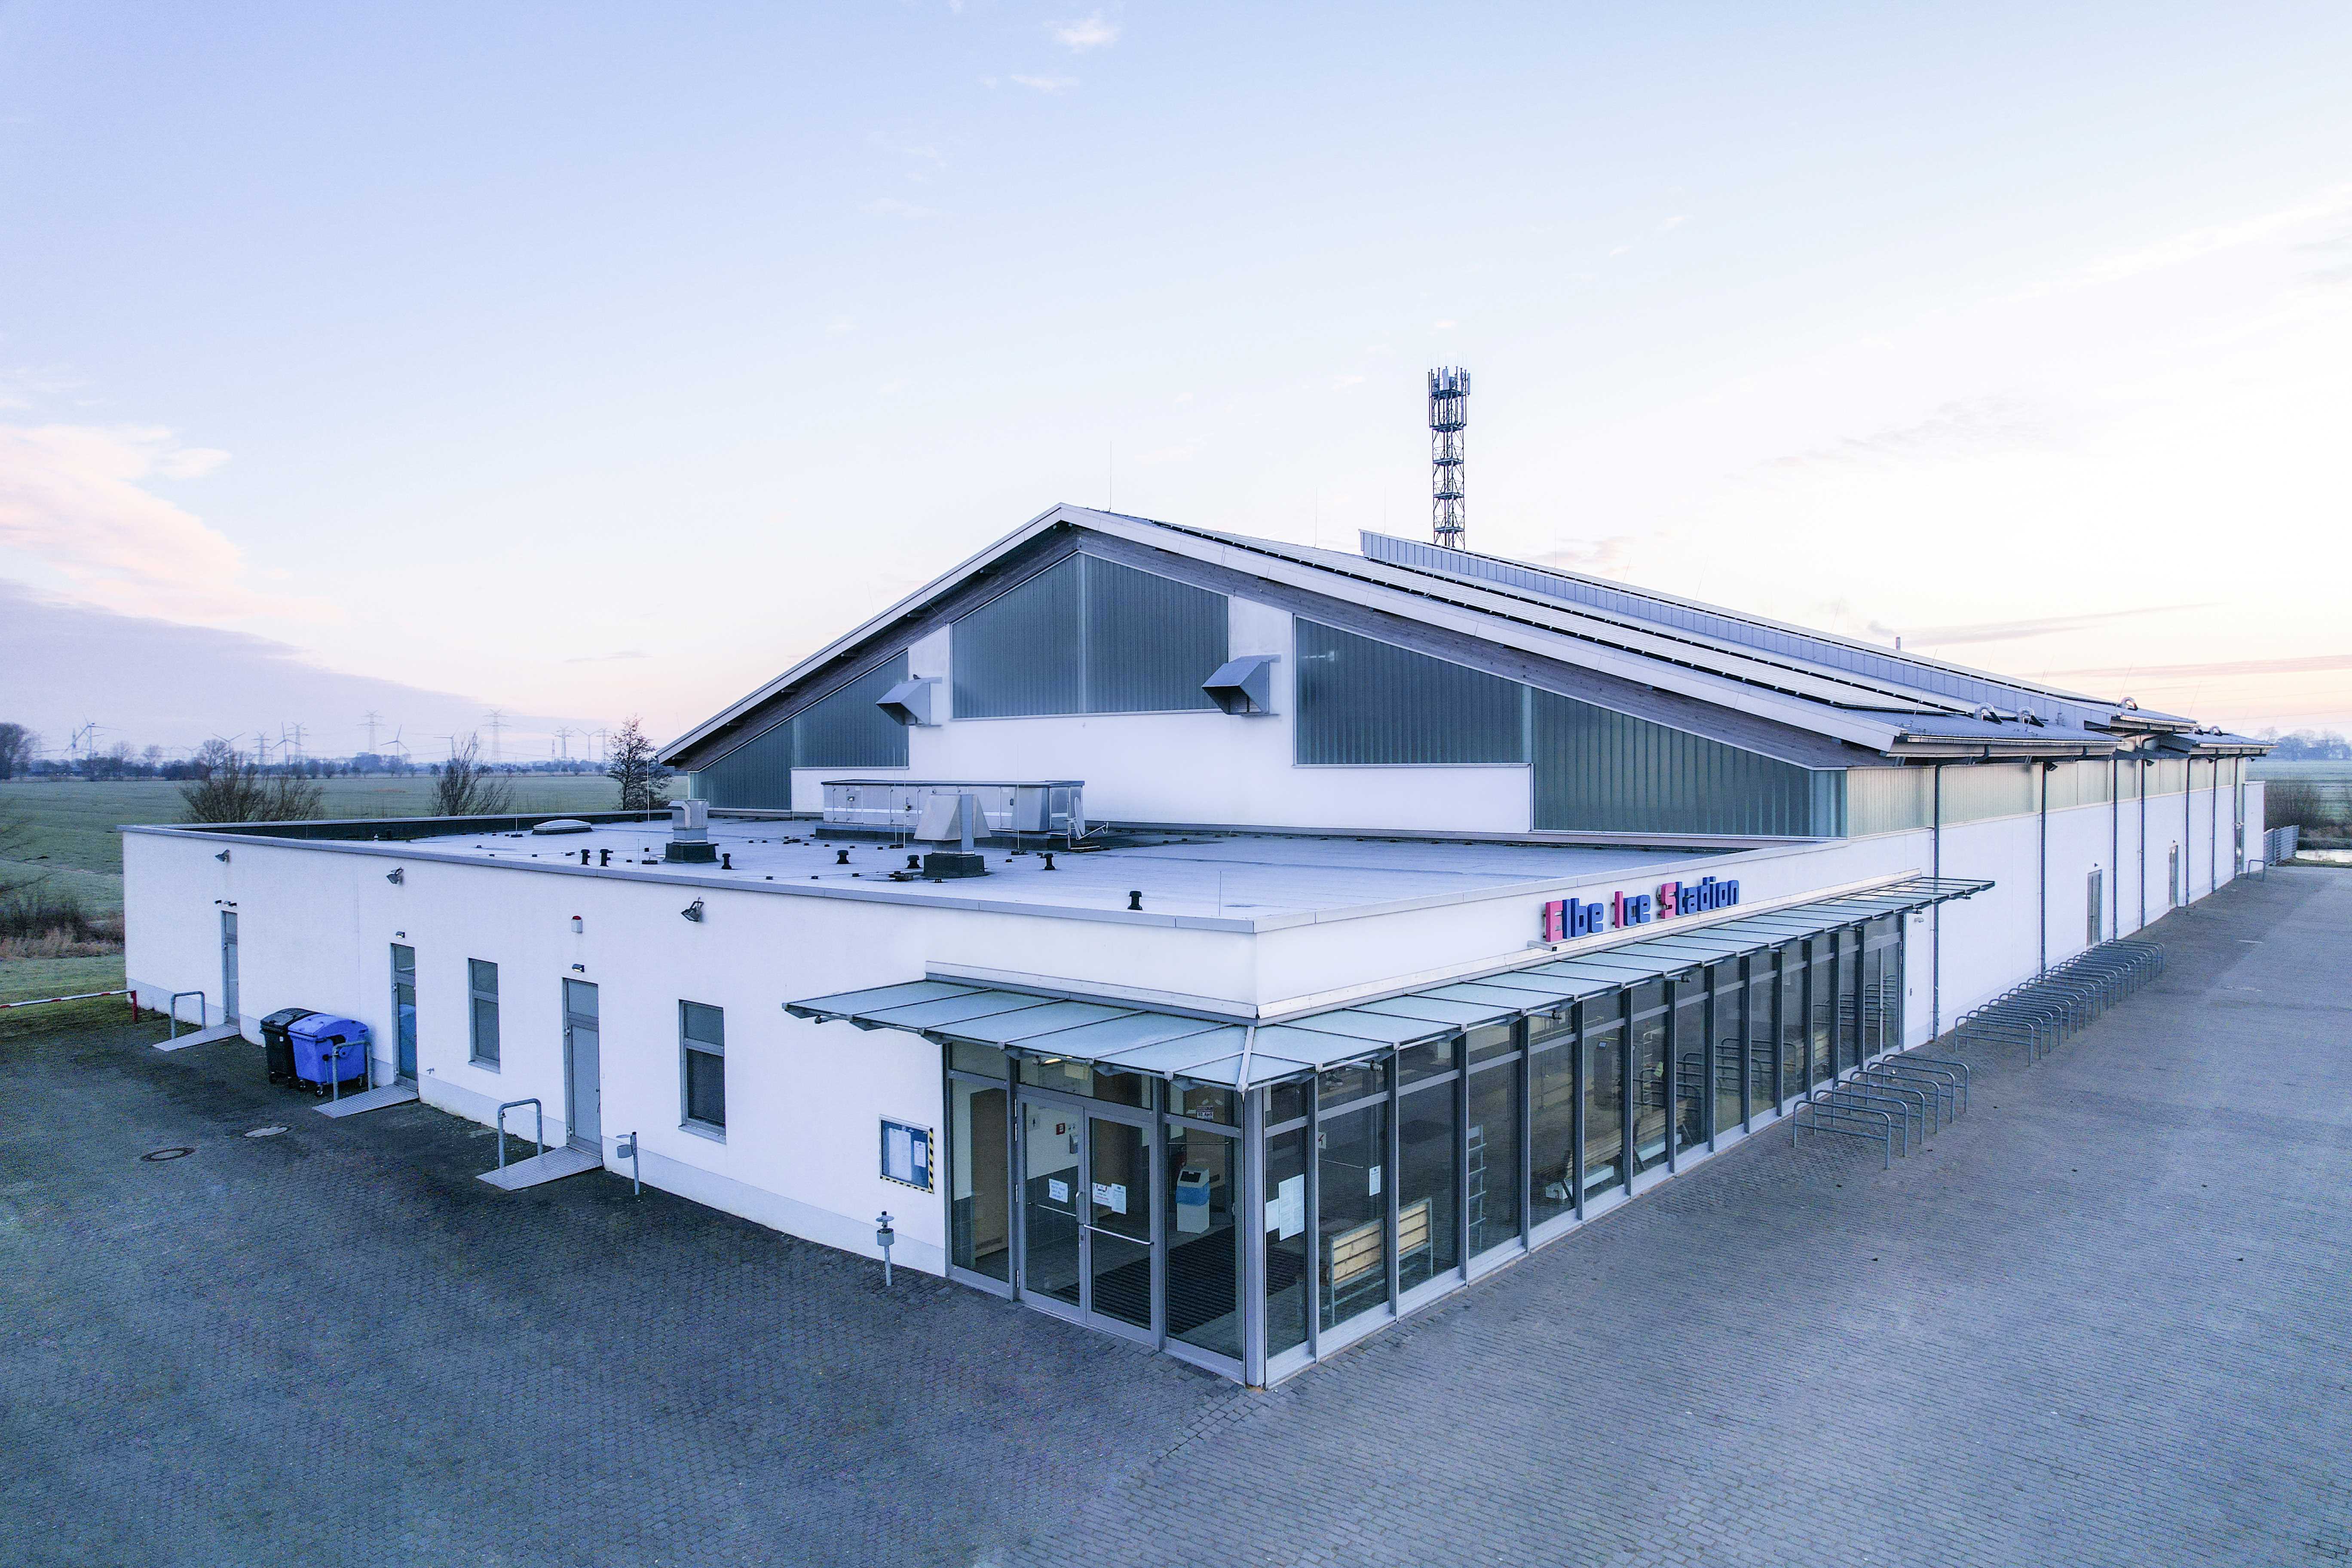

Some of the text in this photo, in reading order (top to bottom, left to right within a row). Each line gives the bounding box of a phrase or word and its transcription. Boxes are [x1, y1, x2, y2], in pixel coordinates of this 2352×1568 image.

[1546, 876, 1739, 942] Elbe Ice Stadion
